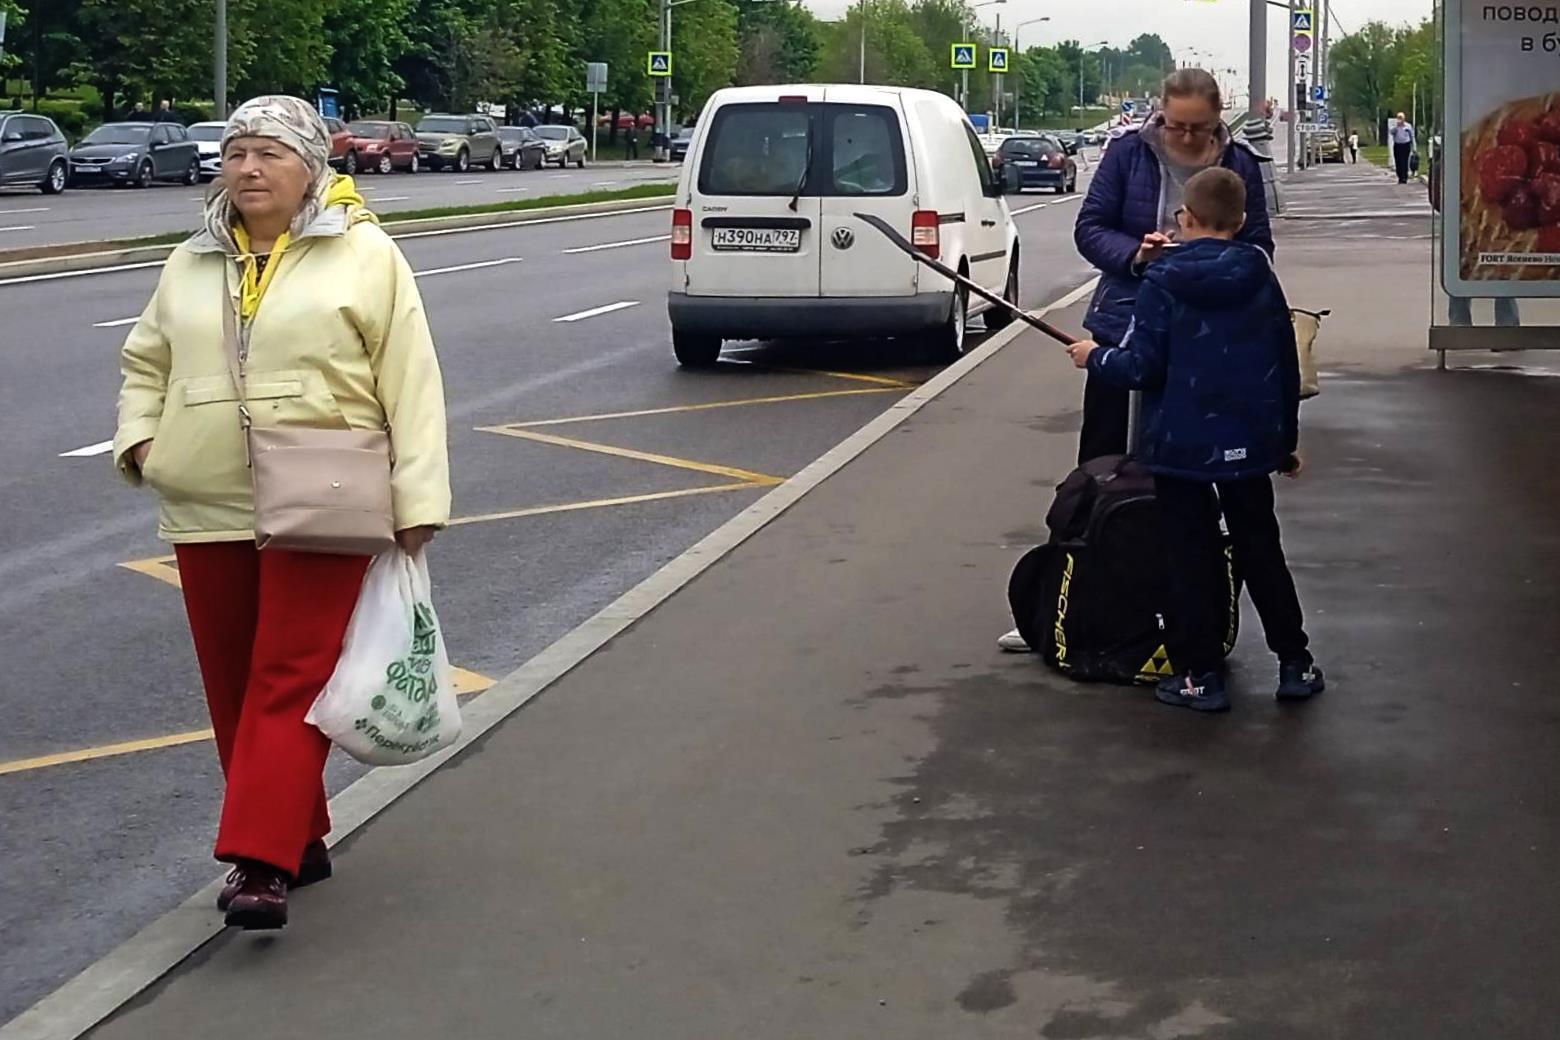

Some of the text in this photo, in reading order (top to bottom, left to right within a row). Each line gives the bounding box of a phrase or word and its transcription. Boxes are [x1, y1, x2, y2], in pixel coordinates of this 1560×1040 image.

[1483, 5, 1559, 24] повод
[1521, 36, 1533, 51] в
[774, 230, 796, 241] 797
[1481, 254, 1504, 263] FORT
[1055, 552, 1074, 661] FISCHER
